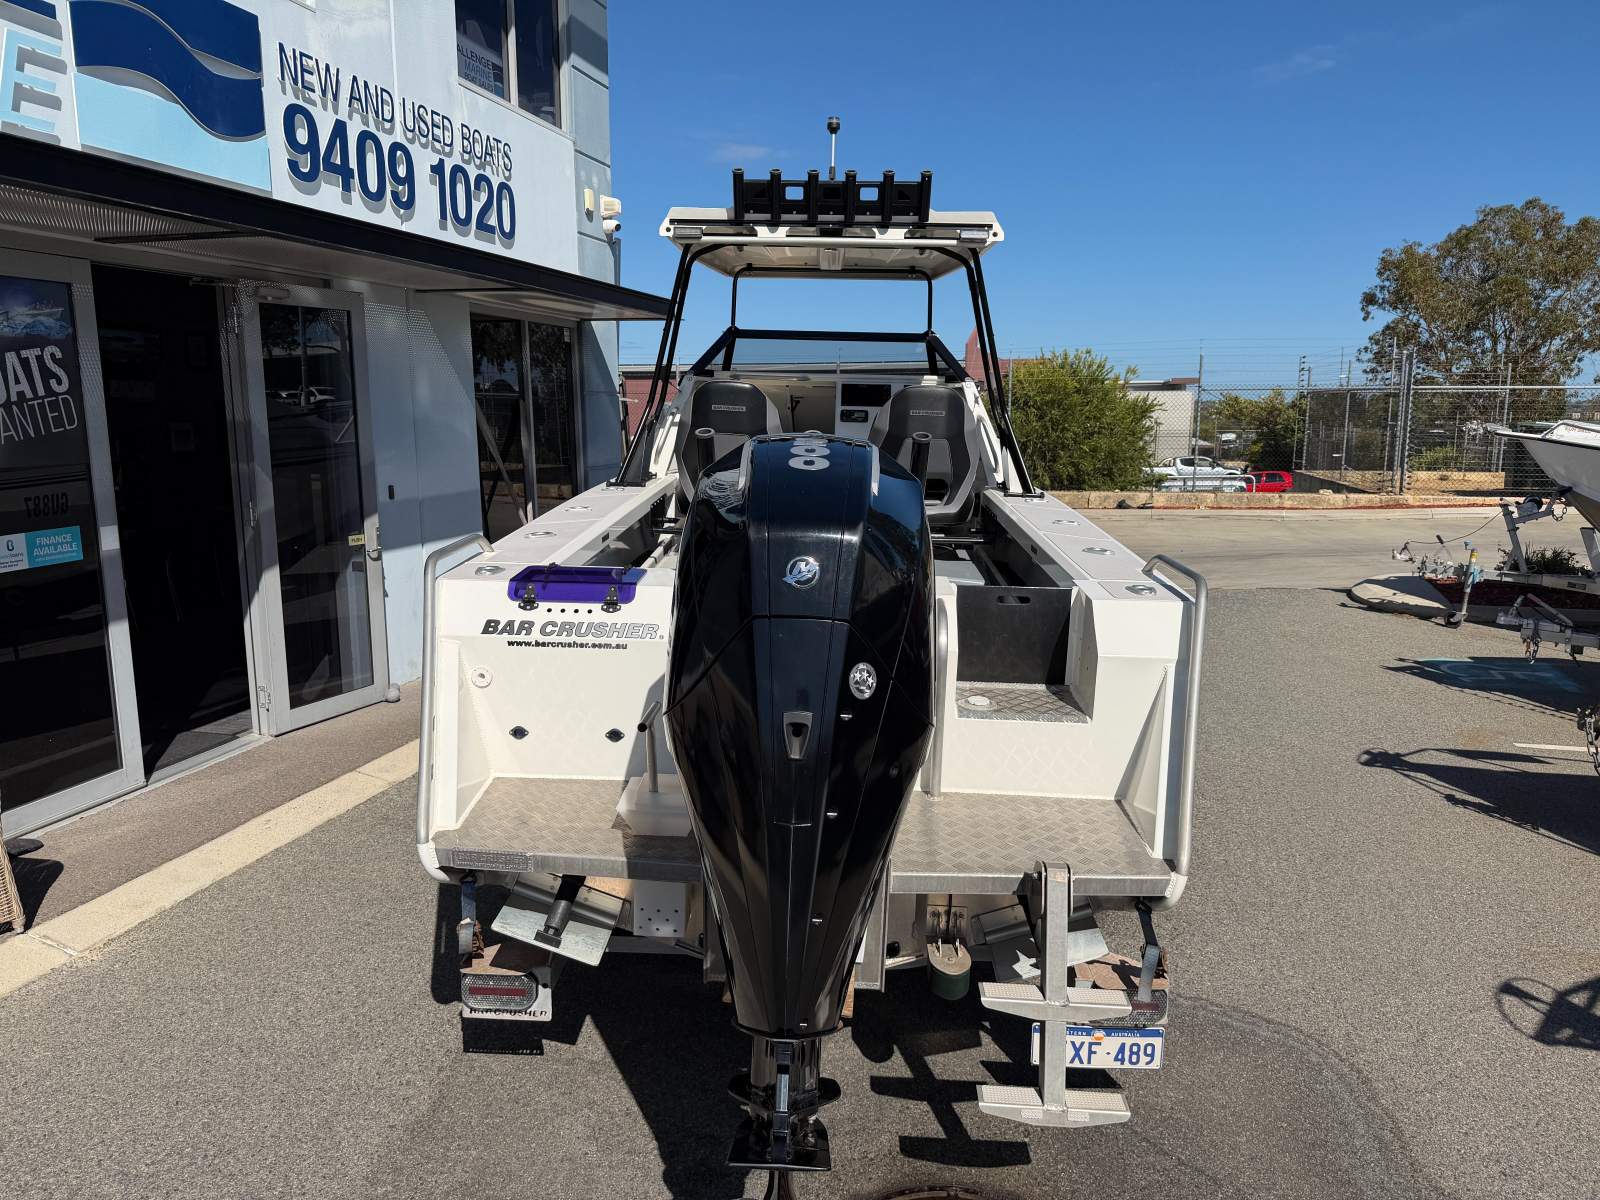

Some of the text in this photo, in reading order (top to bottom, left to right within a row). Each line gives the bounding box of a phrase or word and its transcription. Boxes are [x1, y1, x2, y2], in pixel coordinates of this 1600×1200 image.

[278, 42, 513, 172] NEW AND USED BOATS
[283, 103, 516, 241] 9409 1020
[36, 533, 73, 546] FINANCE
[33, 542, 78, 557] AVAILABLE
[480, 619, 660, 640] BAR CRUSHER
[506, 639, 628, 650] www.barcrusher.com.au
